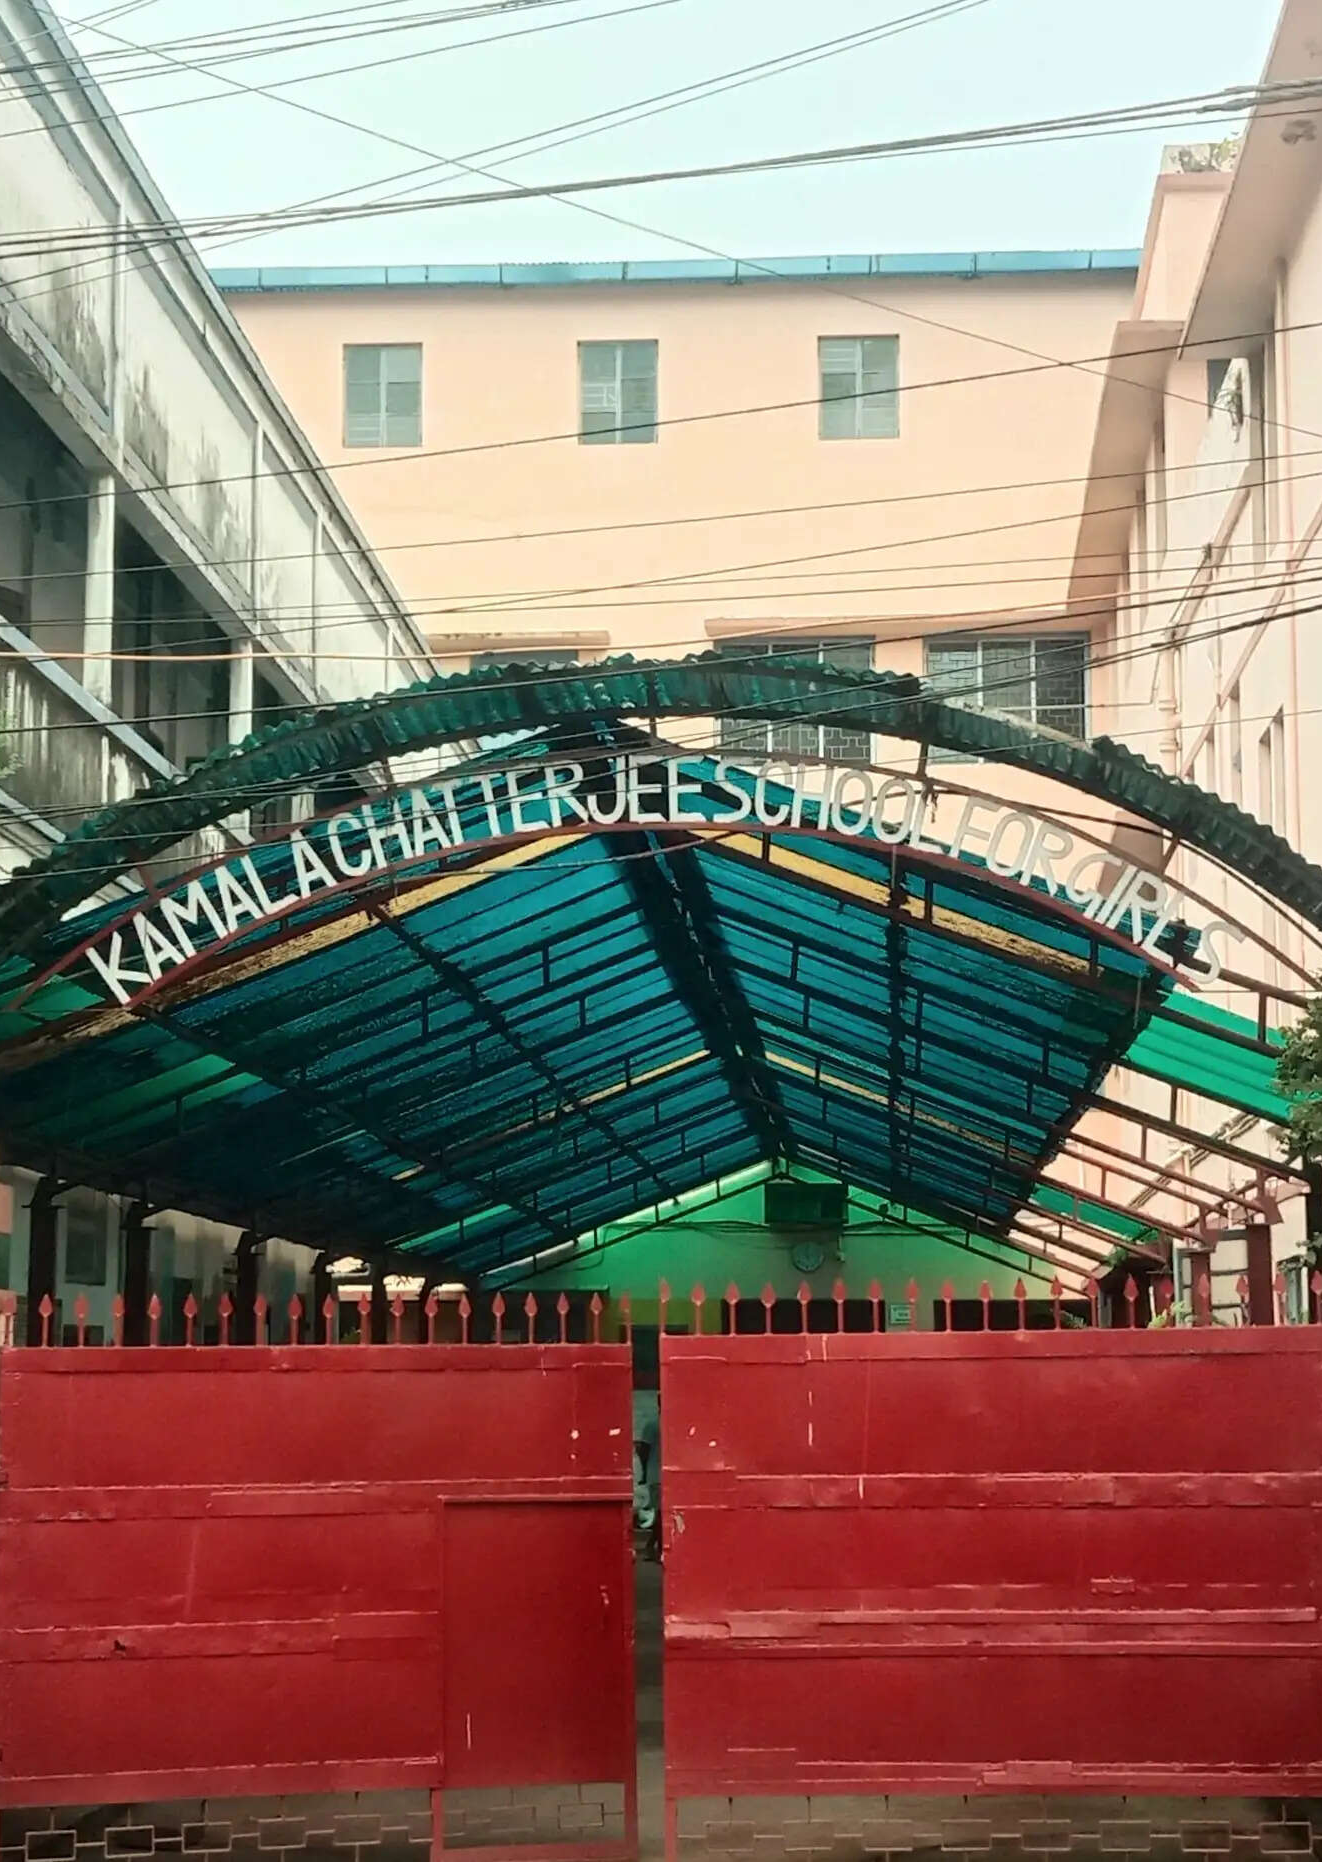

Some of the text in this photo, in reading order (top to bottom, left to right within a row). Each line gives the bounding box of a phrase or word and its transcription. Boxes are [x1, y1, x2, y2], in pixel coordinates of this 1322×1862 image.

[85, 753, 1246, 1005] KAMALA CHATTERJEE SCHOOL FOR GIRLS
